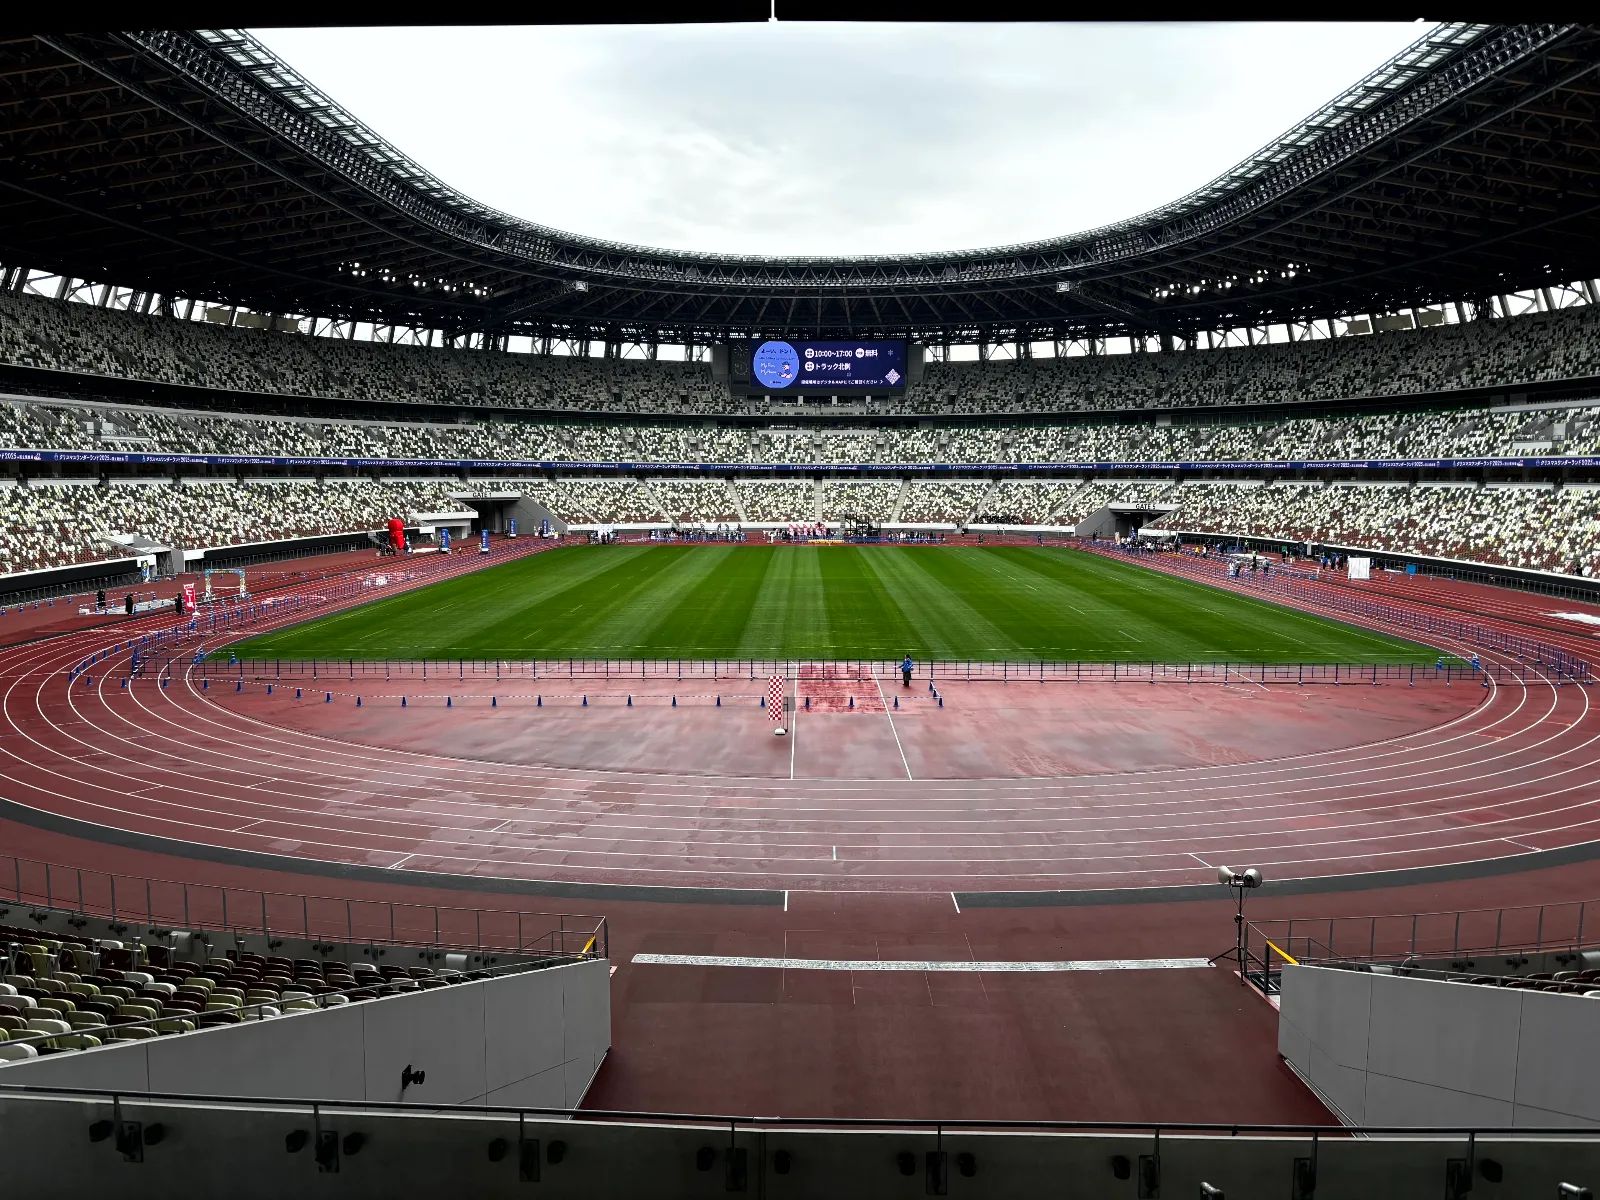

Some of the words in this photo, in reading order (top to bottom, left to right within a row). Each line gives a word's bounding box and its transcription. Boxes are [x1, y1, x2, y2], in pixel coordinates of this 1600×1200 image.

[815, 362, 851, 371] トラック北側
[473, 490, 487, 498] GATE
